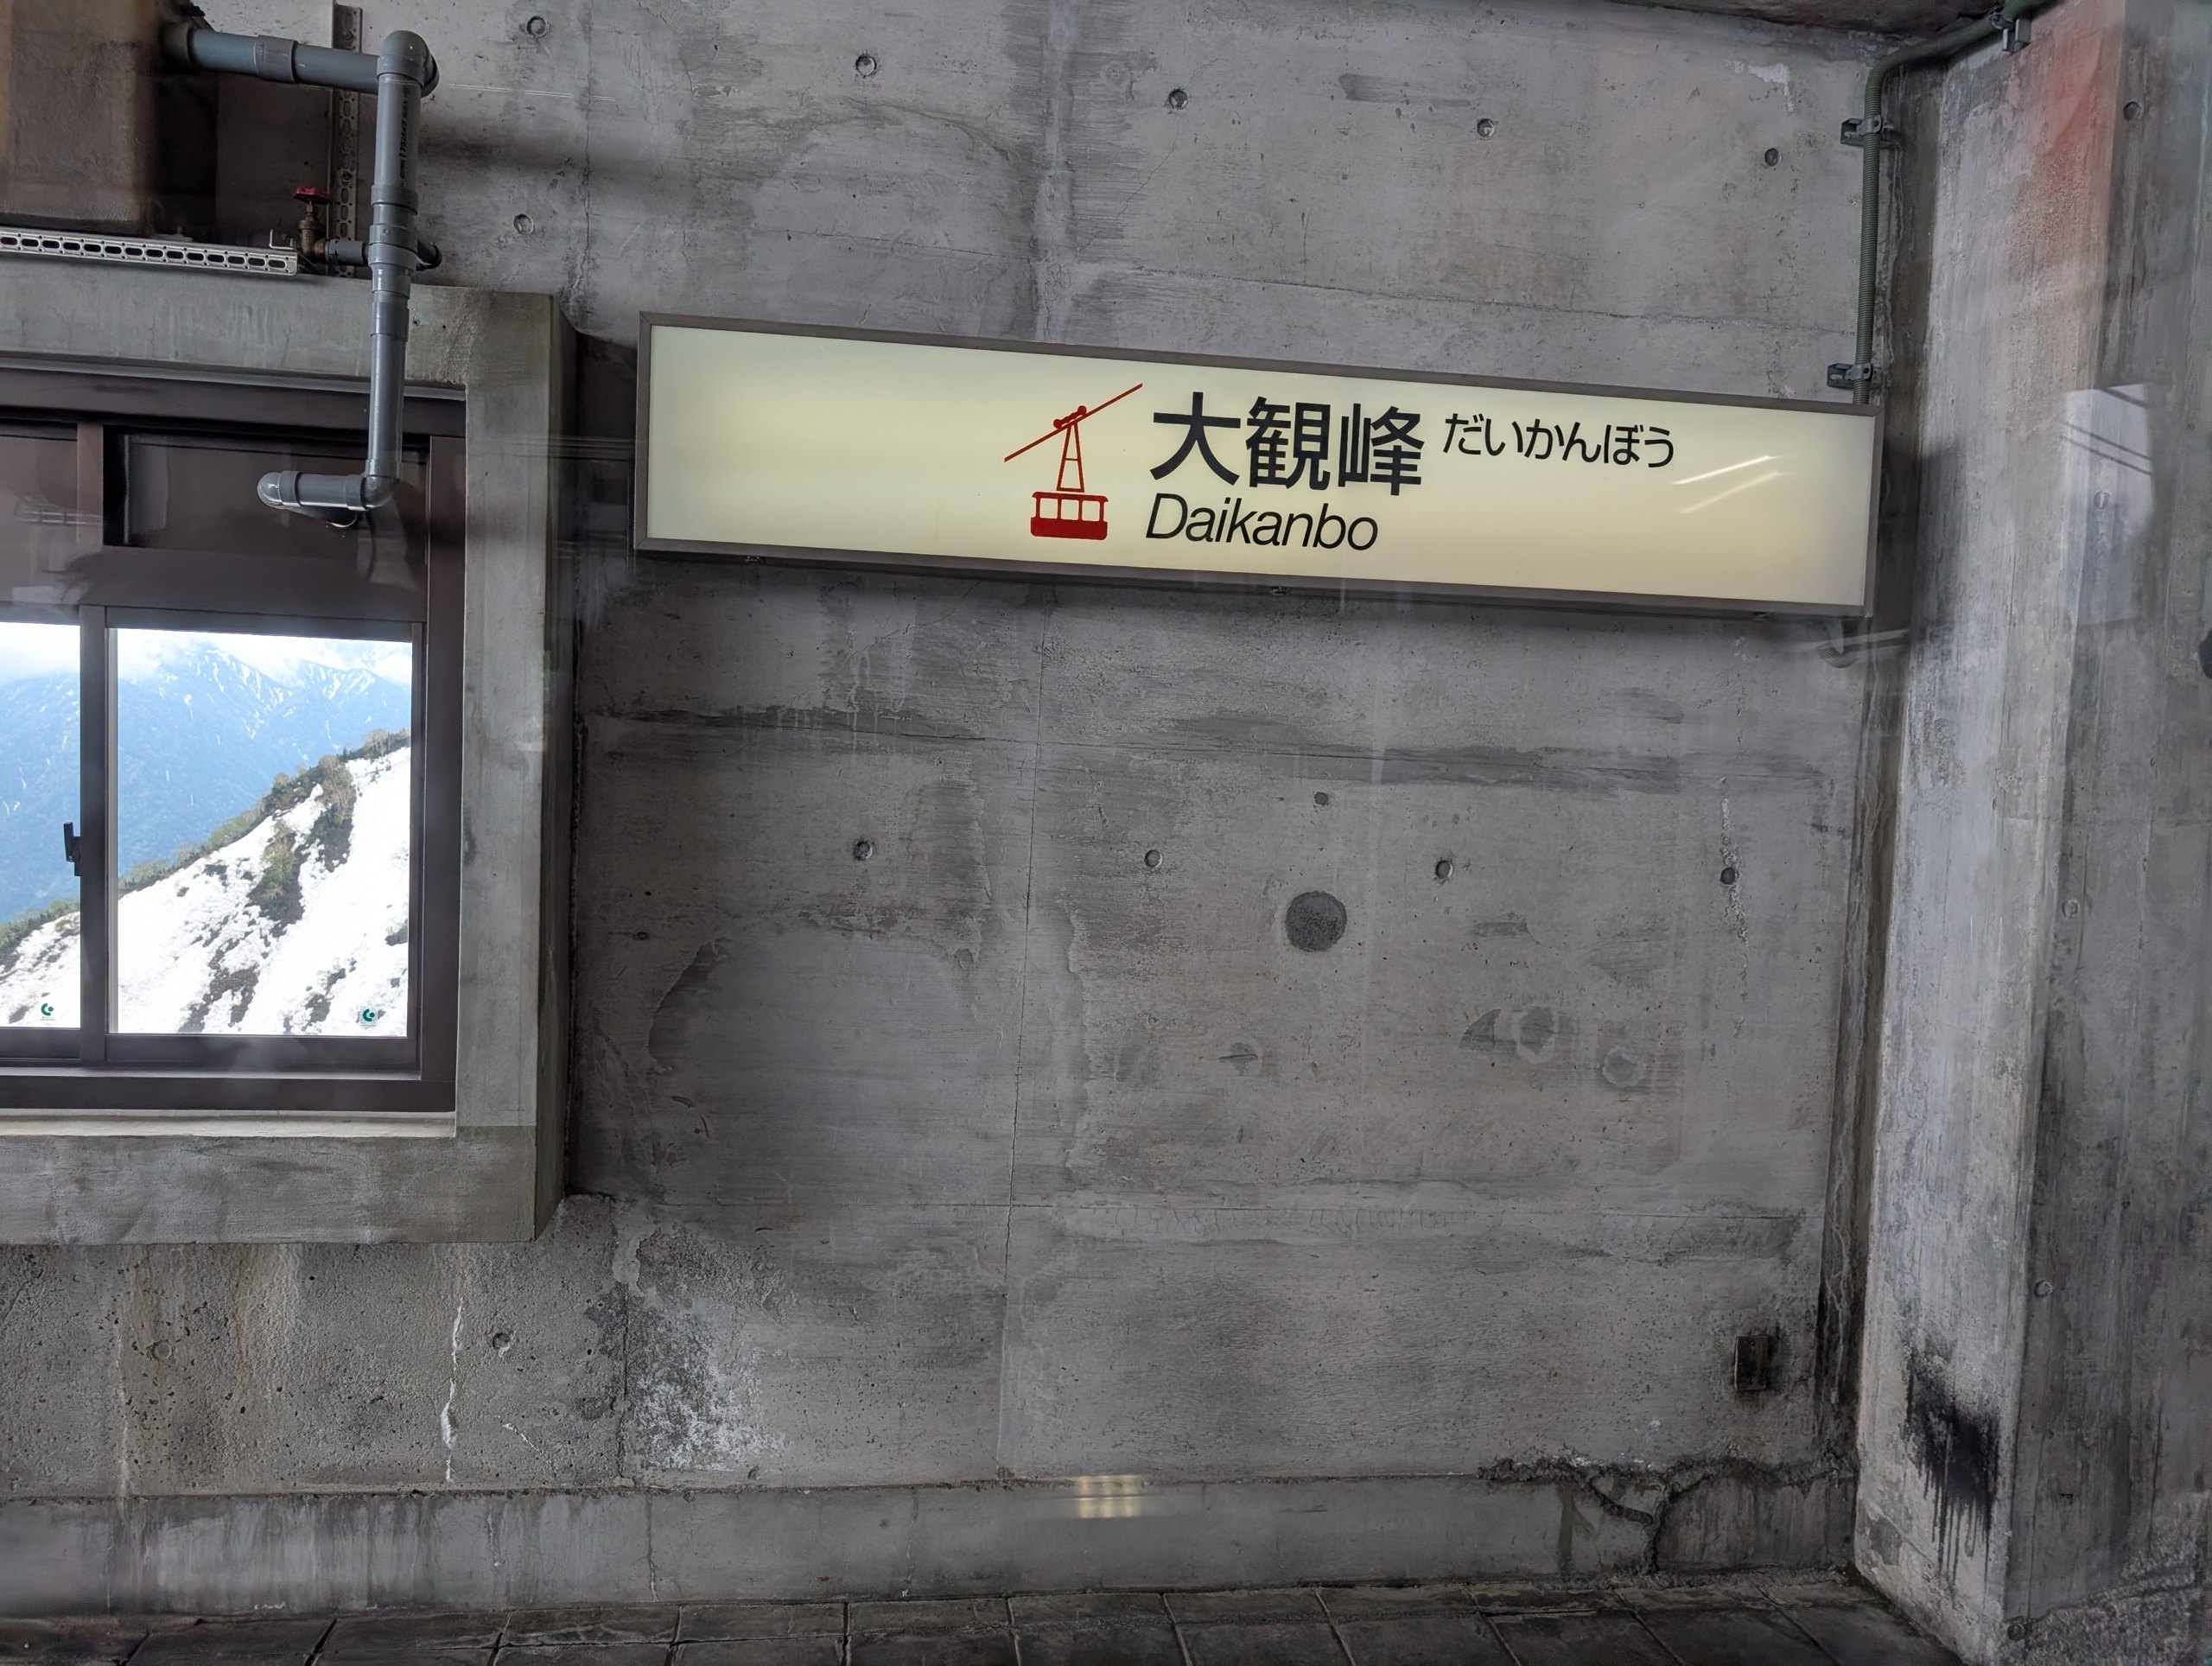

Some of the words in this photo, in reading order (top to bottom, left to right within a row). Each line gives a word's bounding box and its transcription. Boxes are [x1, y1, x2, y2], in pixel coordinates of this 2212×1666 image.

[1150, 391, 1424, 496] 大観峰
[1443, 413, 1675, 468] だいかんぼう
[1146, 493, 1378, 551] Daikanbo
